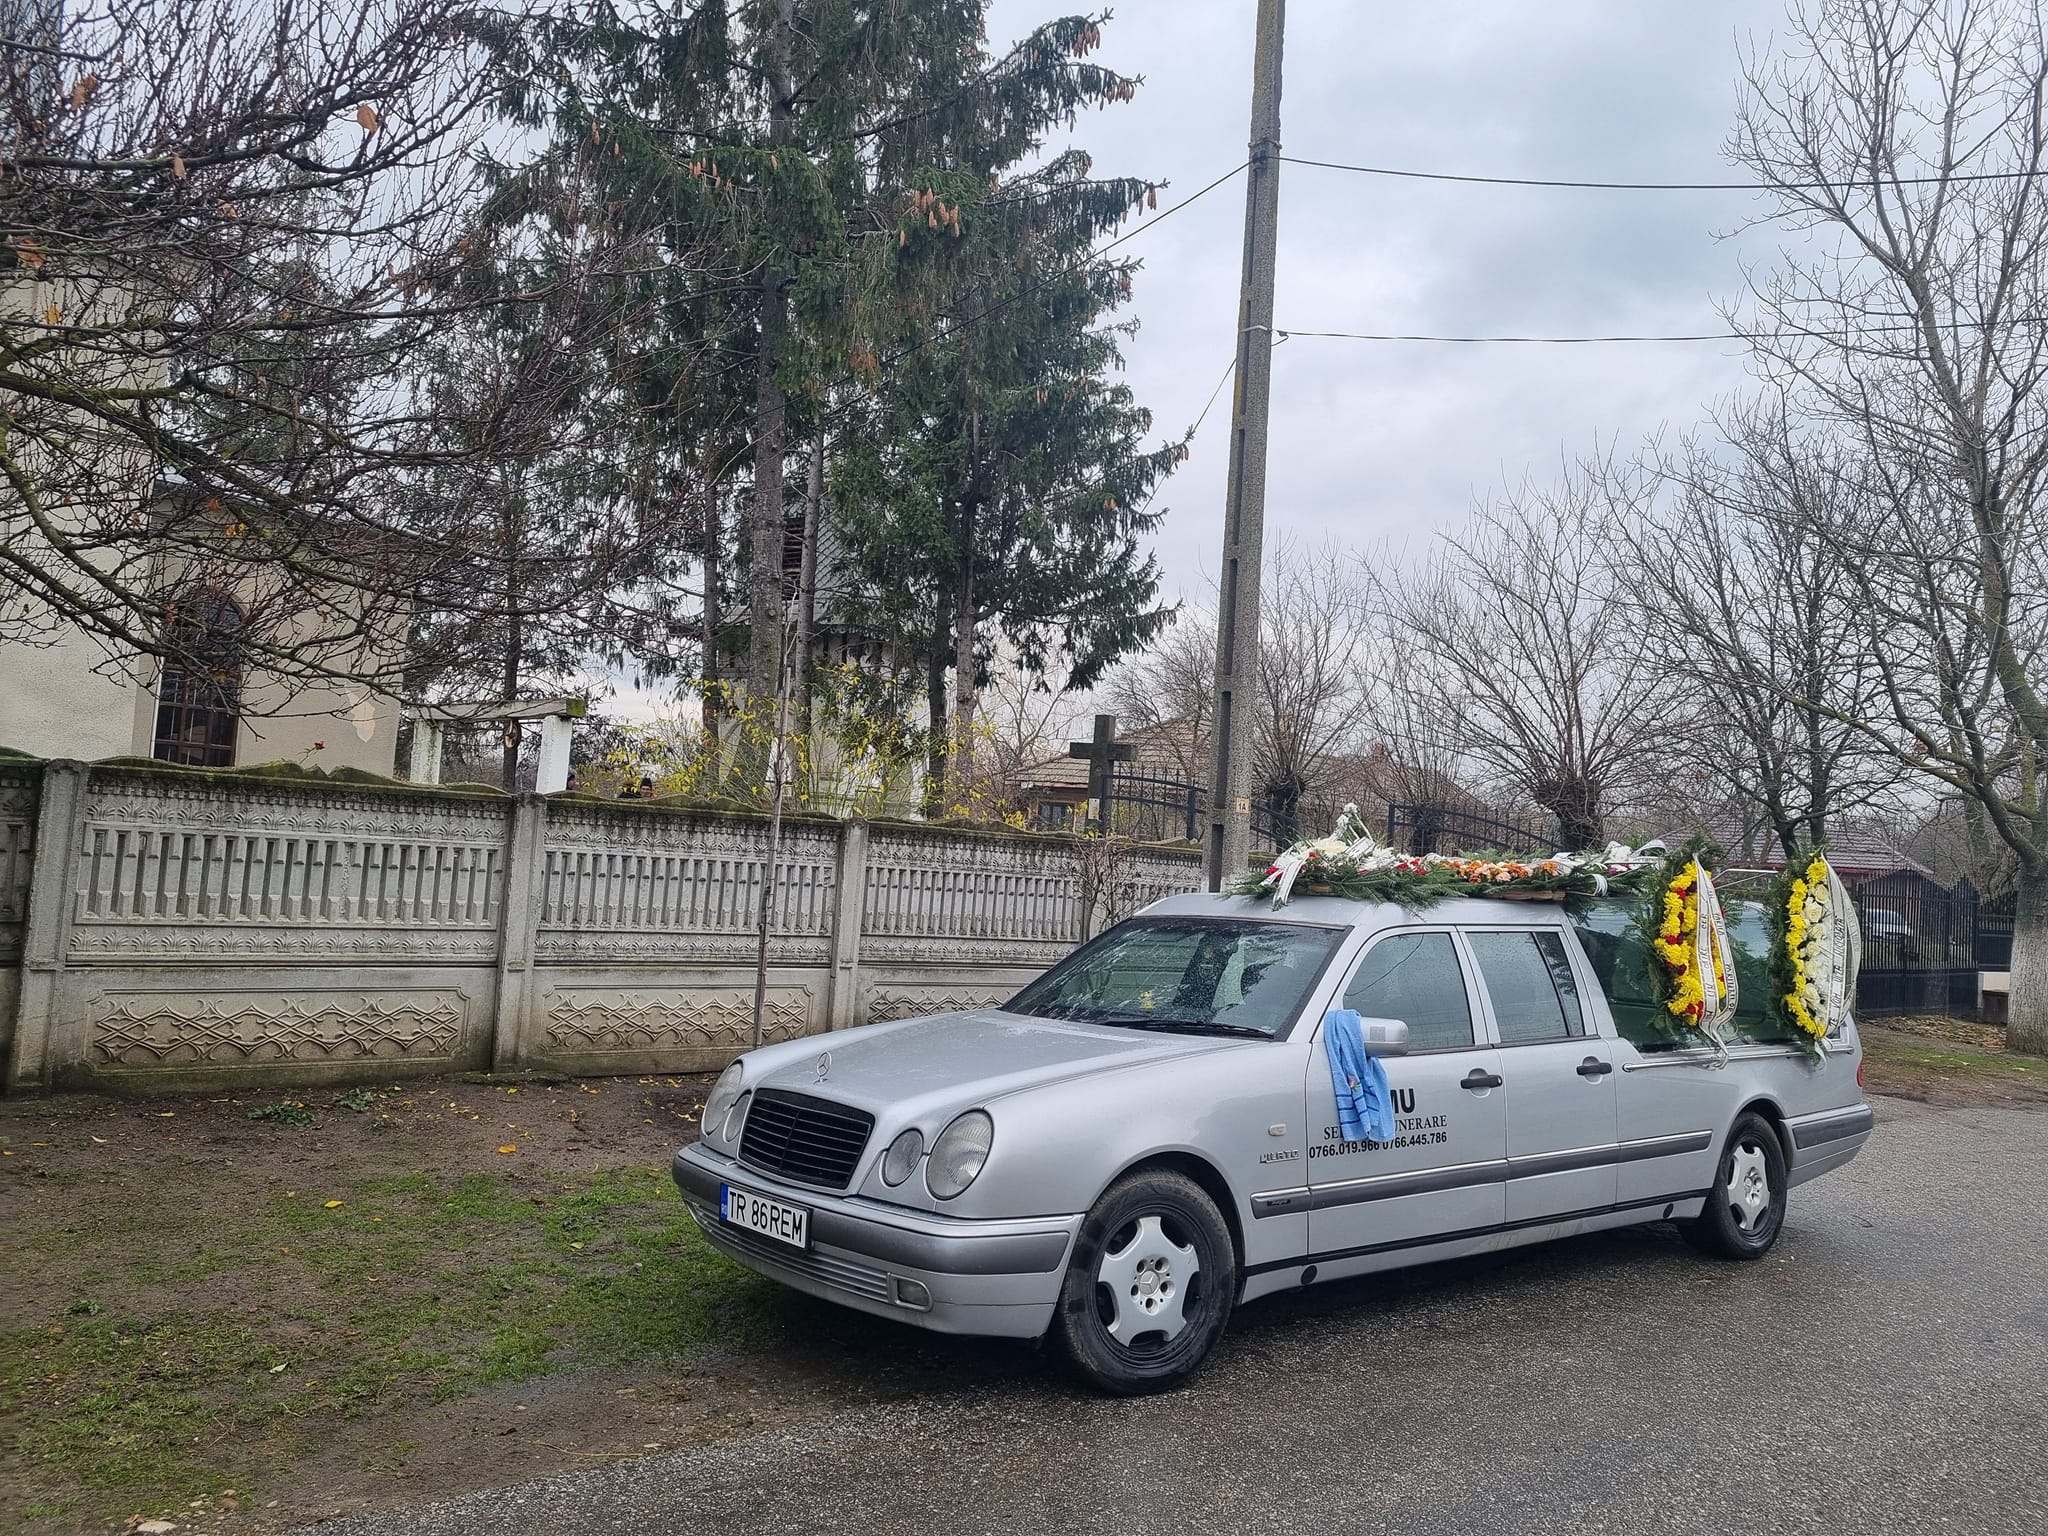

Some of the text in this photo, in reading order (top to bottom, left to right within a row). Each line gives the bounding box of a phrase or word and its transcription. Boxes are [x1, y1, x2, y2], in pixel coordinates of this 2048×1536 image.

[1323, 1114, 1448, 1140] SE NERARE
[729, 1191, 803, 1243] TR 86REM
